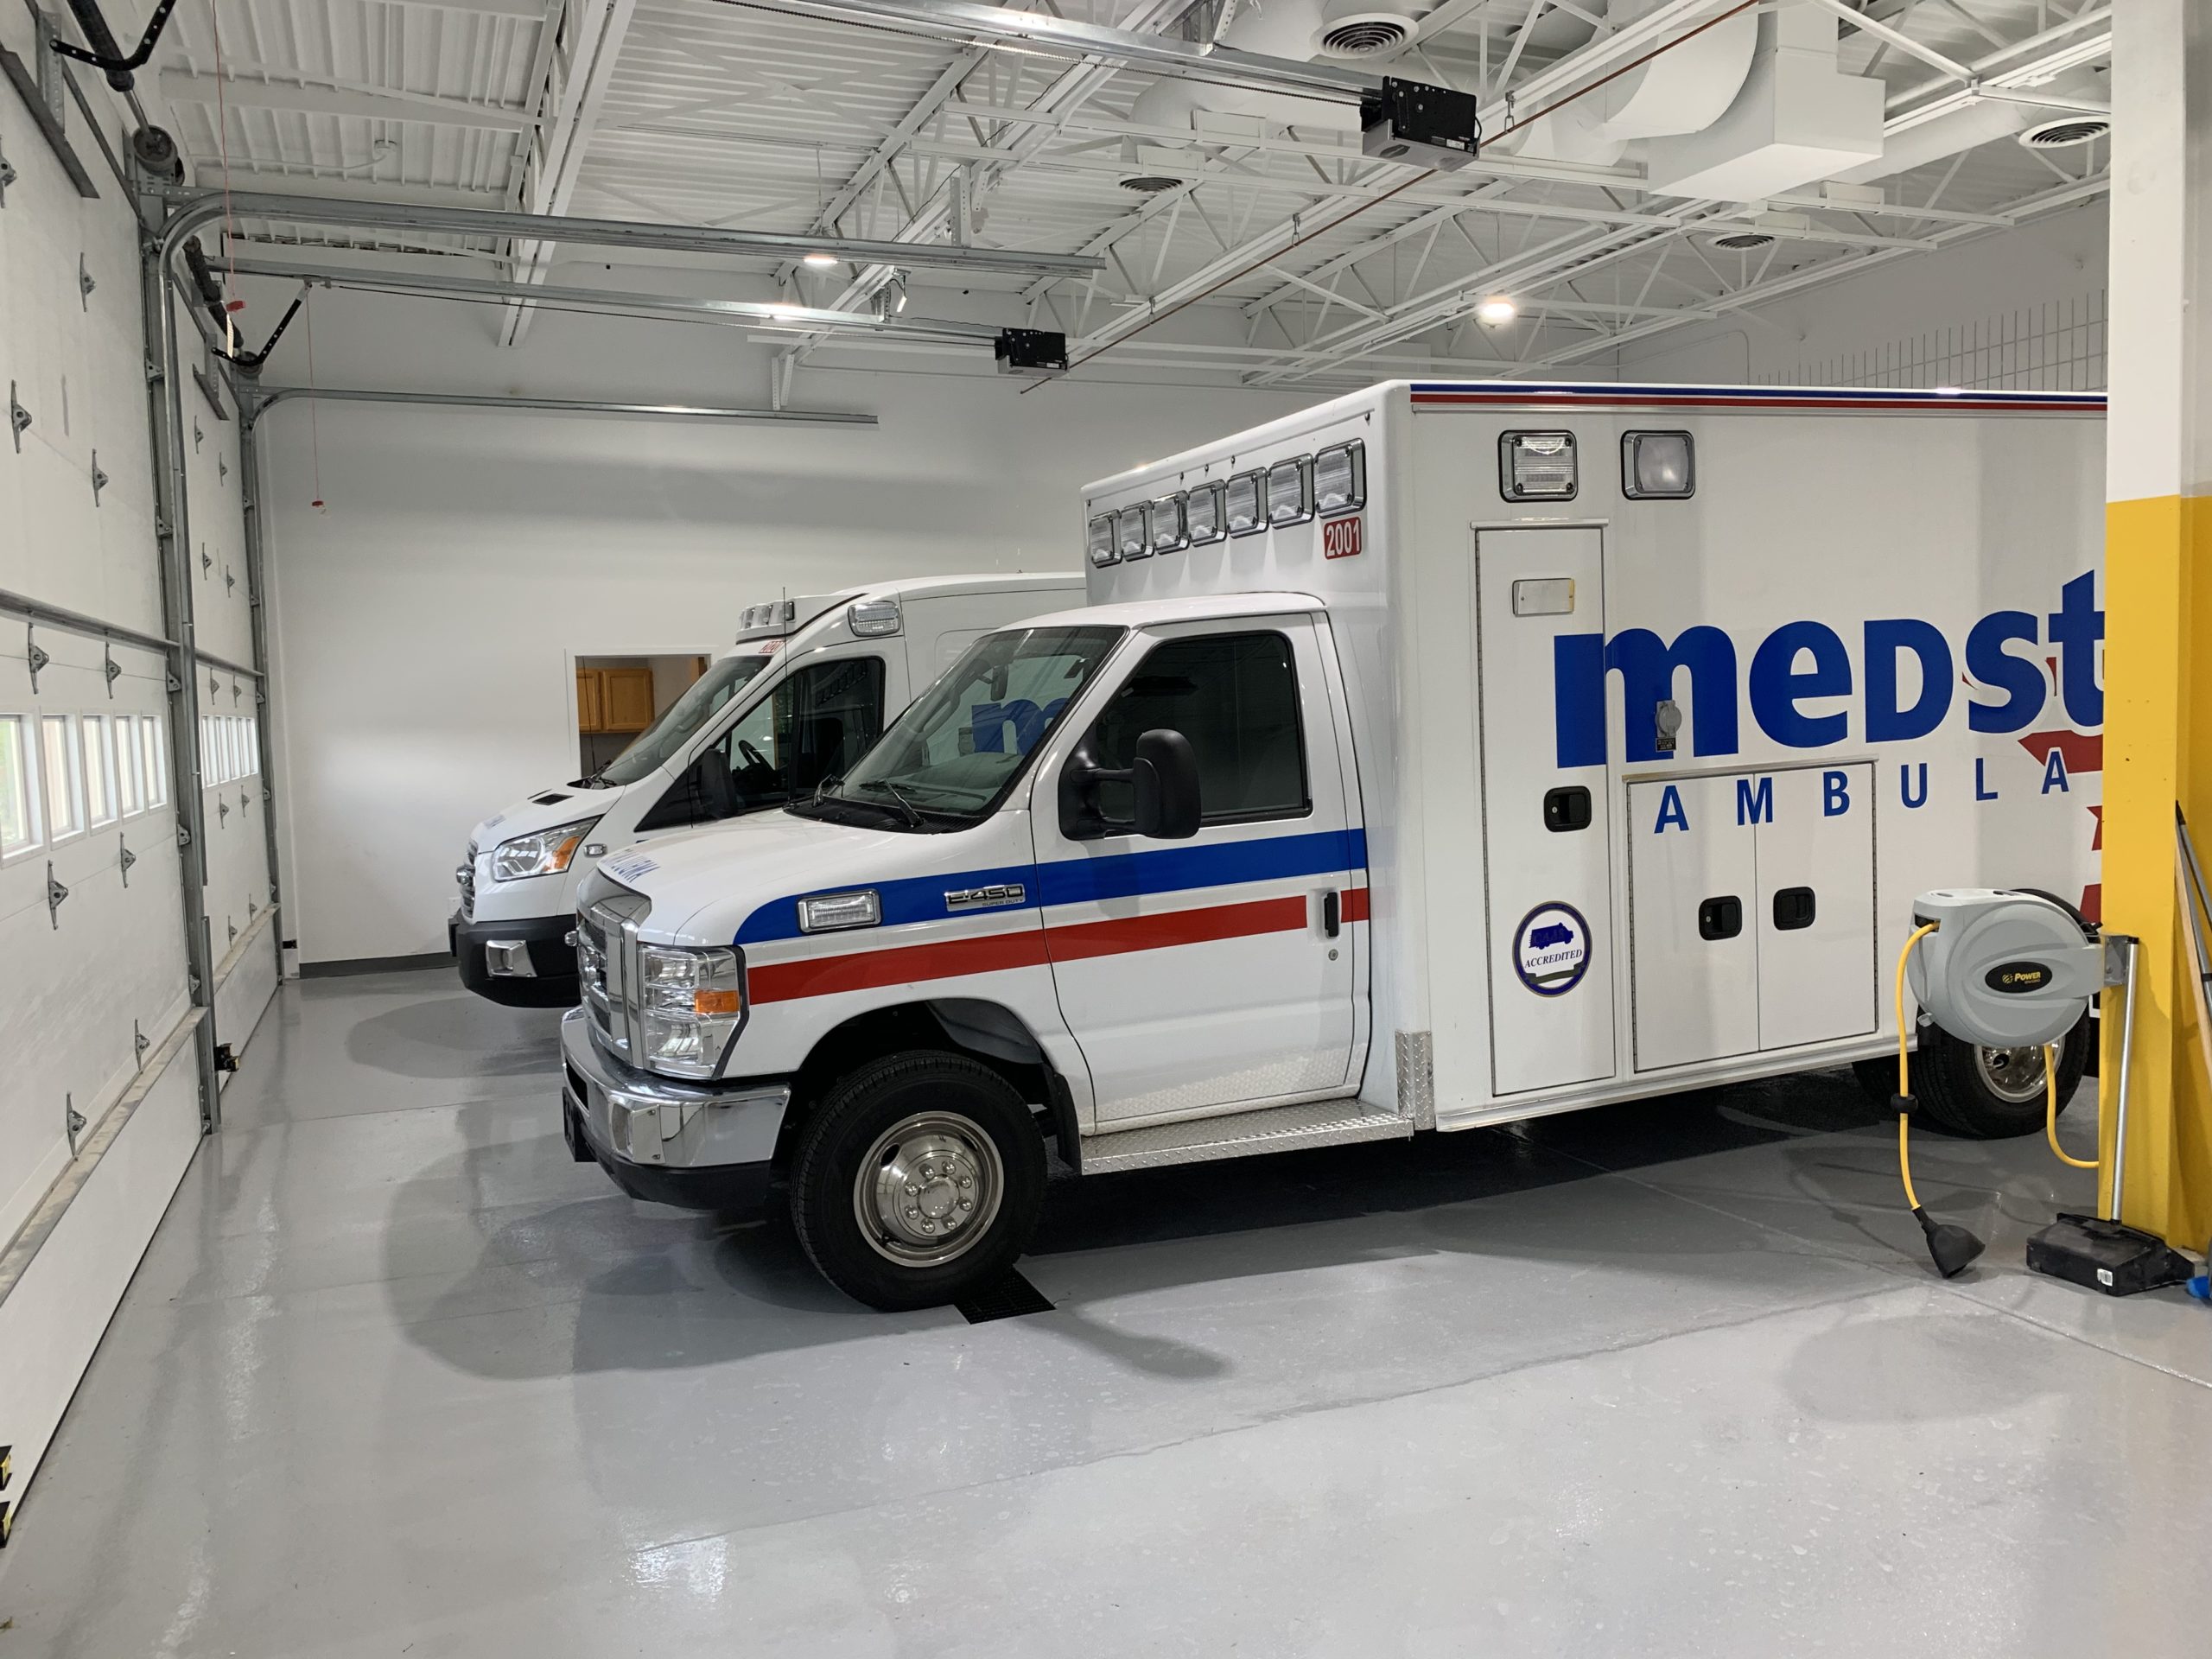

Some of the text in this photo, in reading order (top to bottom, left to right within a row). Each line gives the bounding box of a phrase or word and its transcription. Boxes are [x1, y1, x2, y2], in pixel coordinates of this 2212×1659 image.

[1326, 519, 1360, 557] 2001
[1654, 751, 2069, 834] AMBULA
[947, 886, 1024, 904] E-450
[1524, 949, 1582, 968] ACCREDITED
